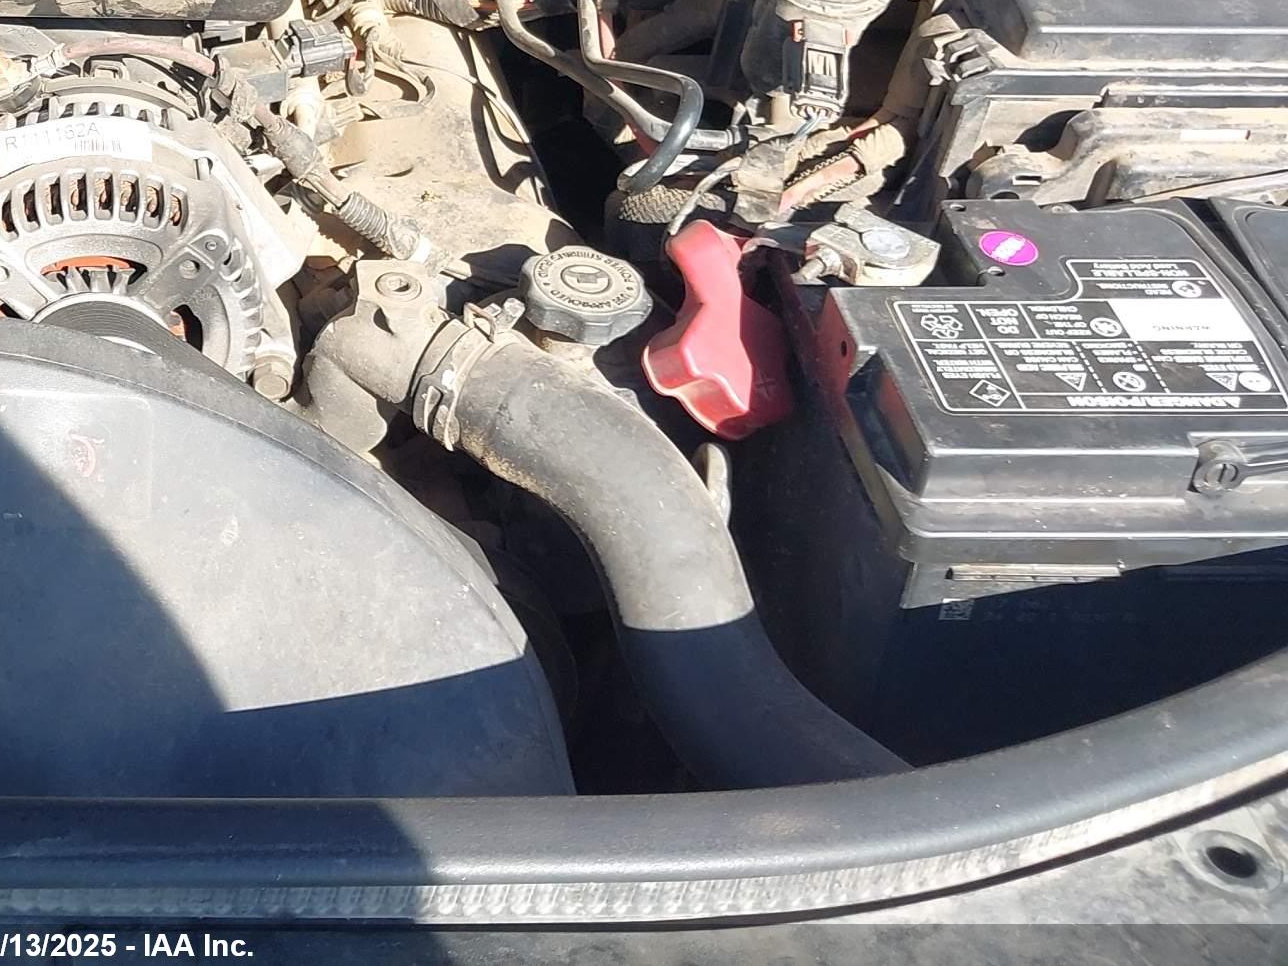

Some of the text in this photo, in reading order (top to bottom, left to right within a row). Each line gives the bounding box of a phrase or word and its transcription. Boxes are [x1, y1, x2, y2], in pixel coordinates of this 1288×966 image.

[604, 258, 635, 284] POWER
[989, 317, 1019, 325] NOT
[997, 325, 1019, 334] DO
